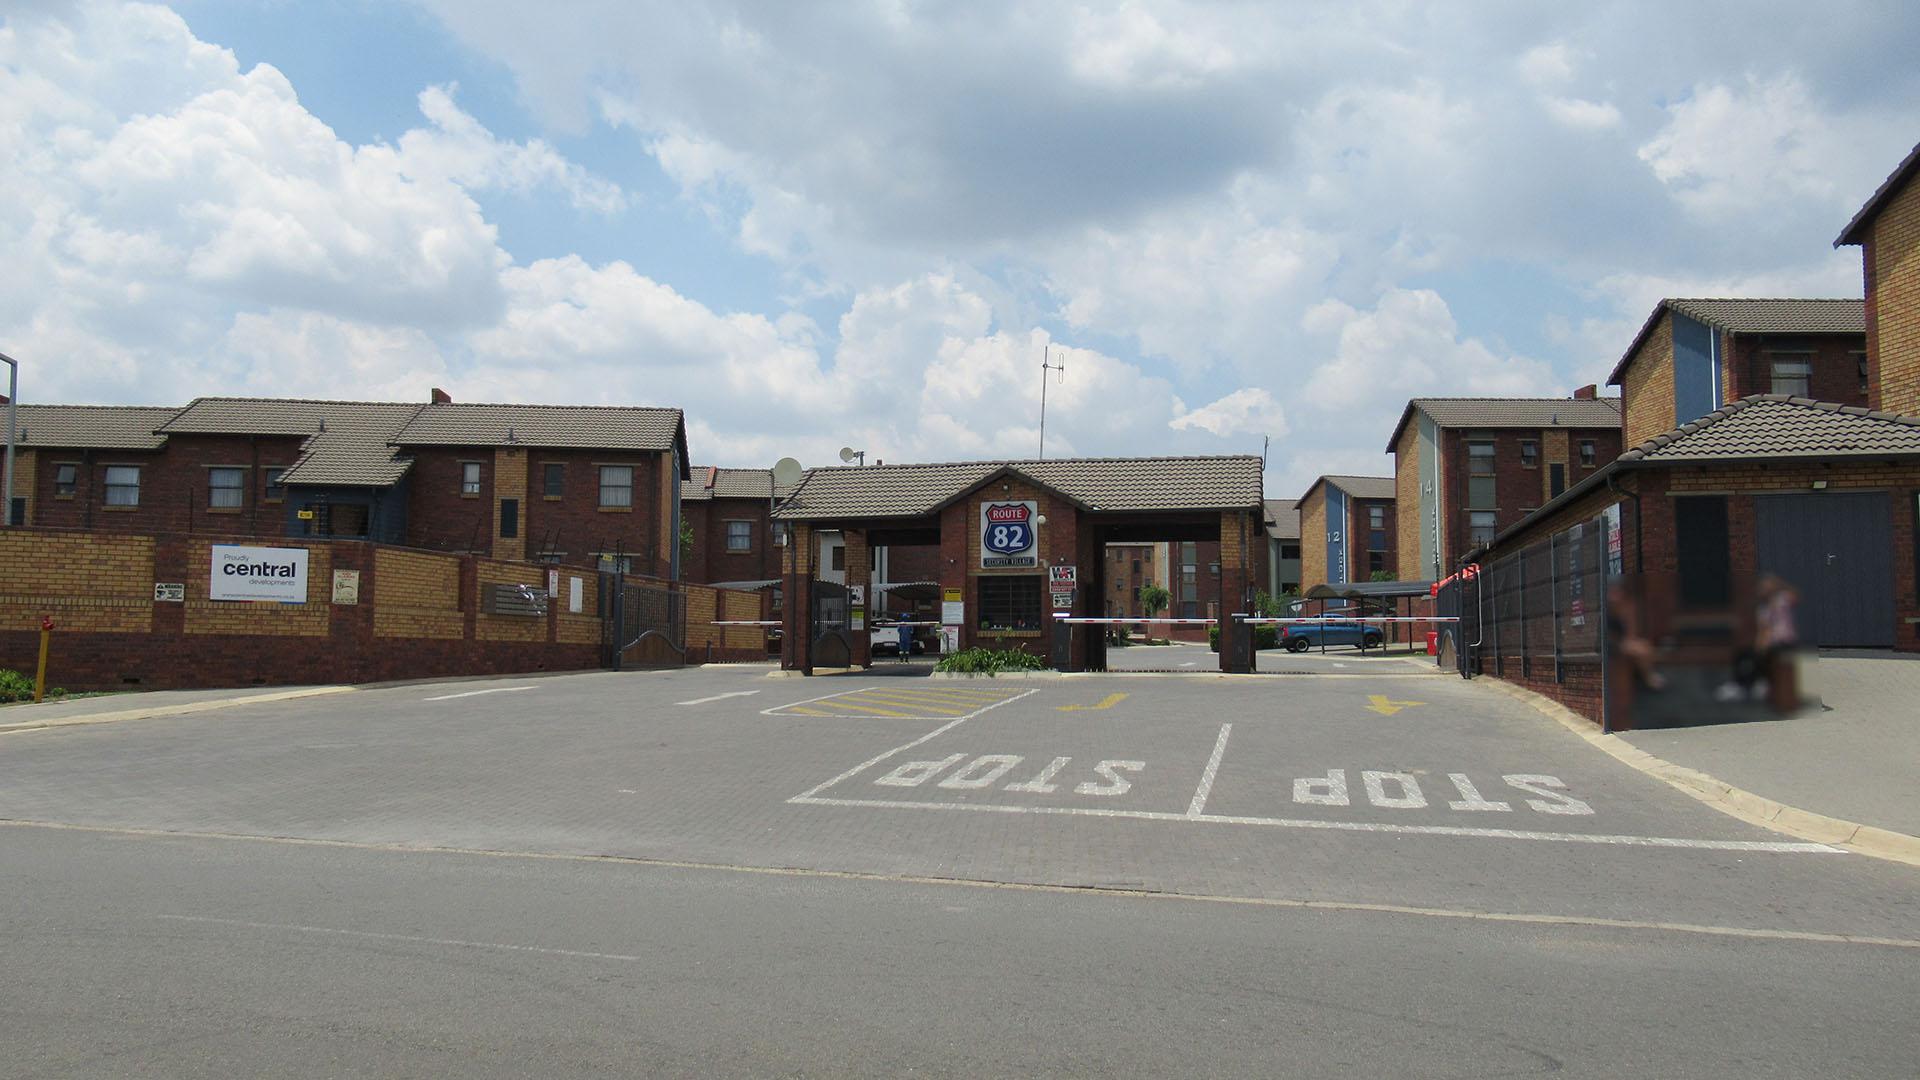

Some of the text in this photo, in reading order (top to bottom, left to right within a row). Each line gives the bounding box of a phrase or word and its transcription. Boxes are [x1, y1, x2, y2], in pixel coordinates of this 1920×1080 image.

[1420, 480, 1432, 497] 14
[993, 509, 1023, 519] ROUTE
[993, 525, 1024, 548] 82
[1327, 531, 1341, 543] 12
[223, 553, 250, 562] Proudly
[223, 561, 296, 578] central
[248, 579, 296, 587] developments
[873, 753, 1147, 796] STOP
[1292, 768, 1596, 815] STOP
